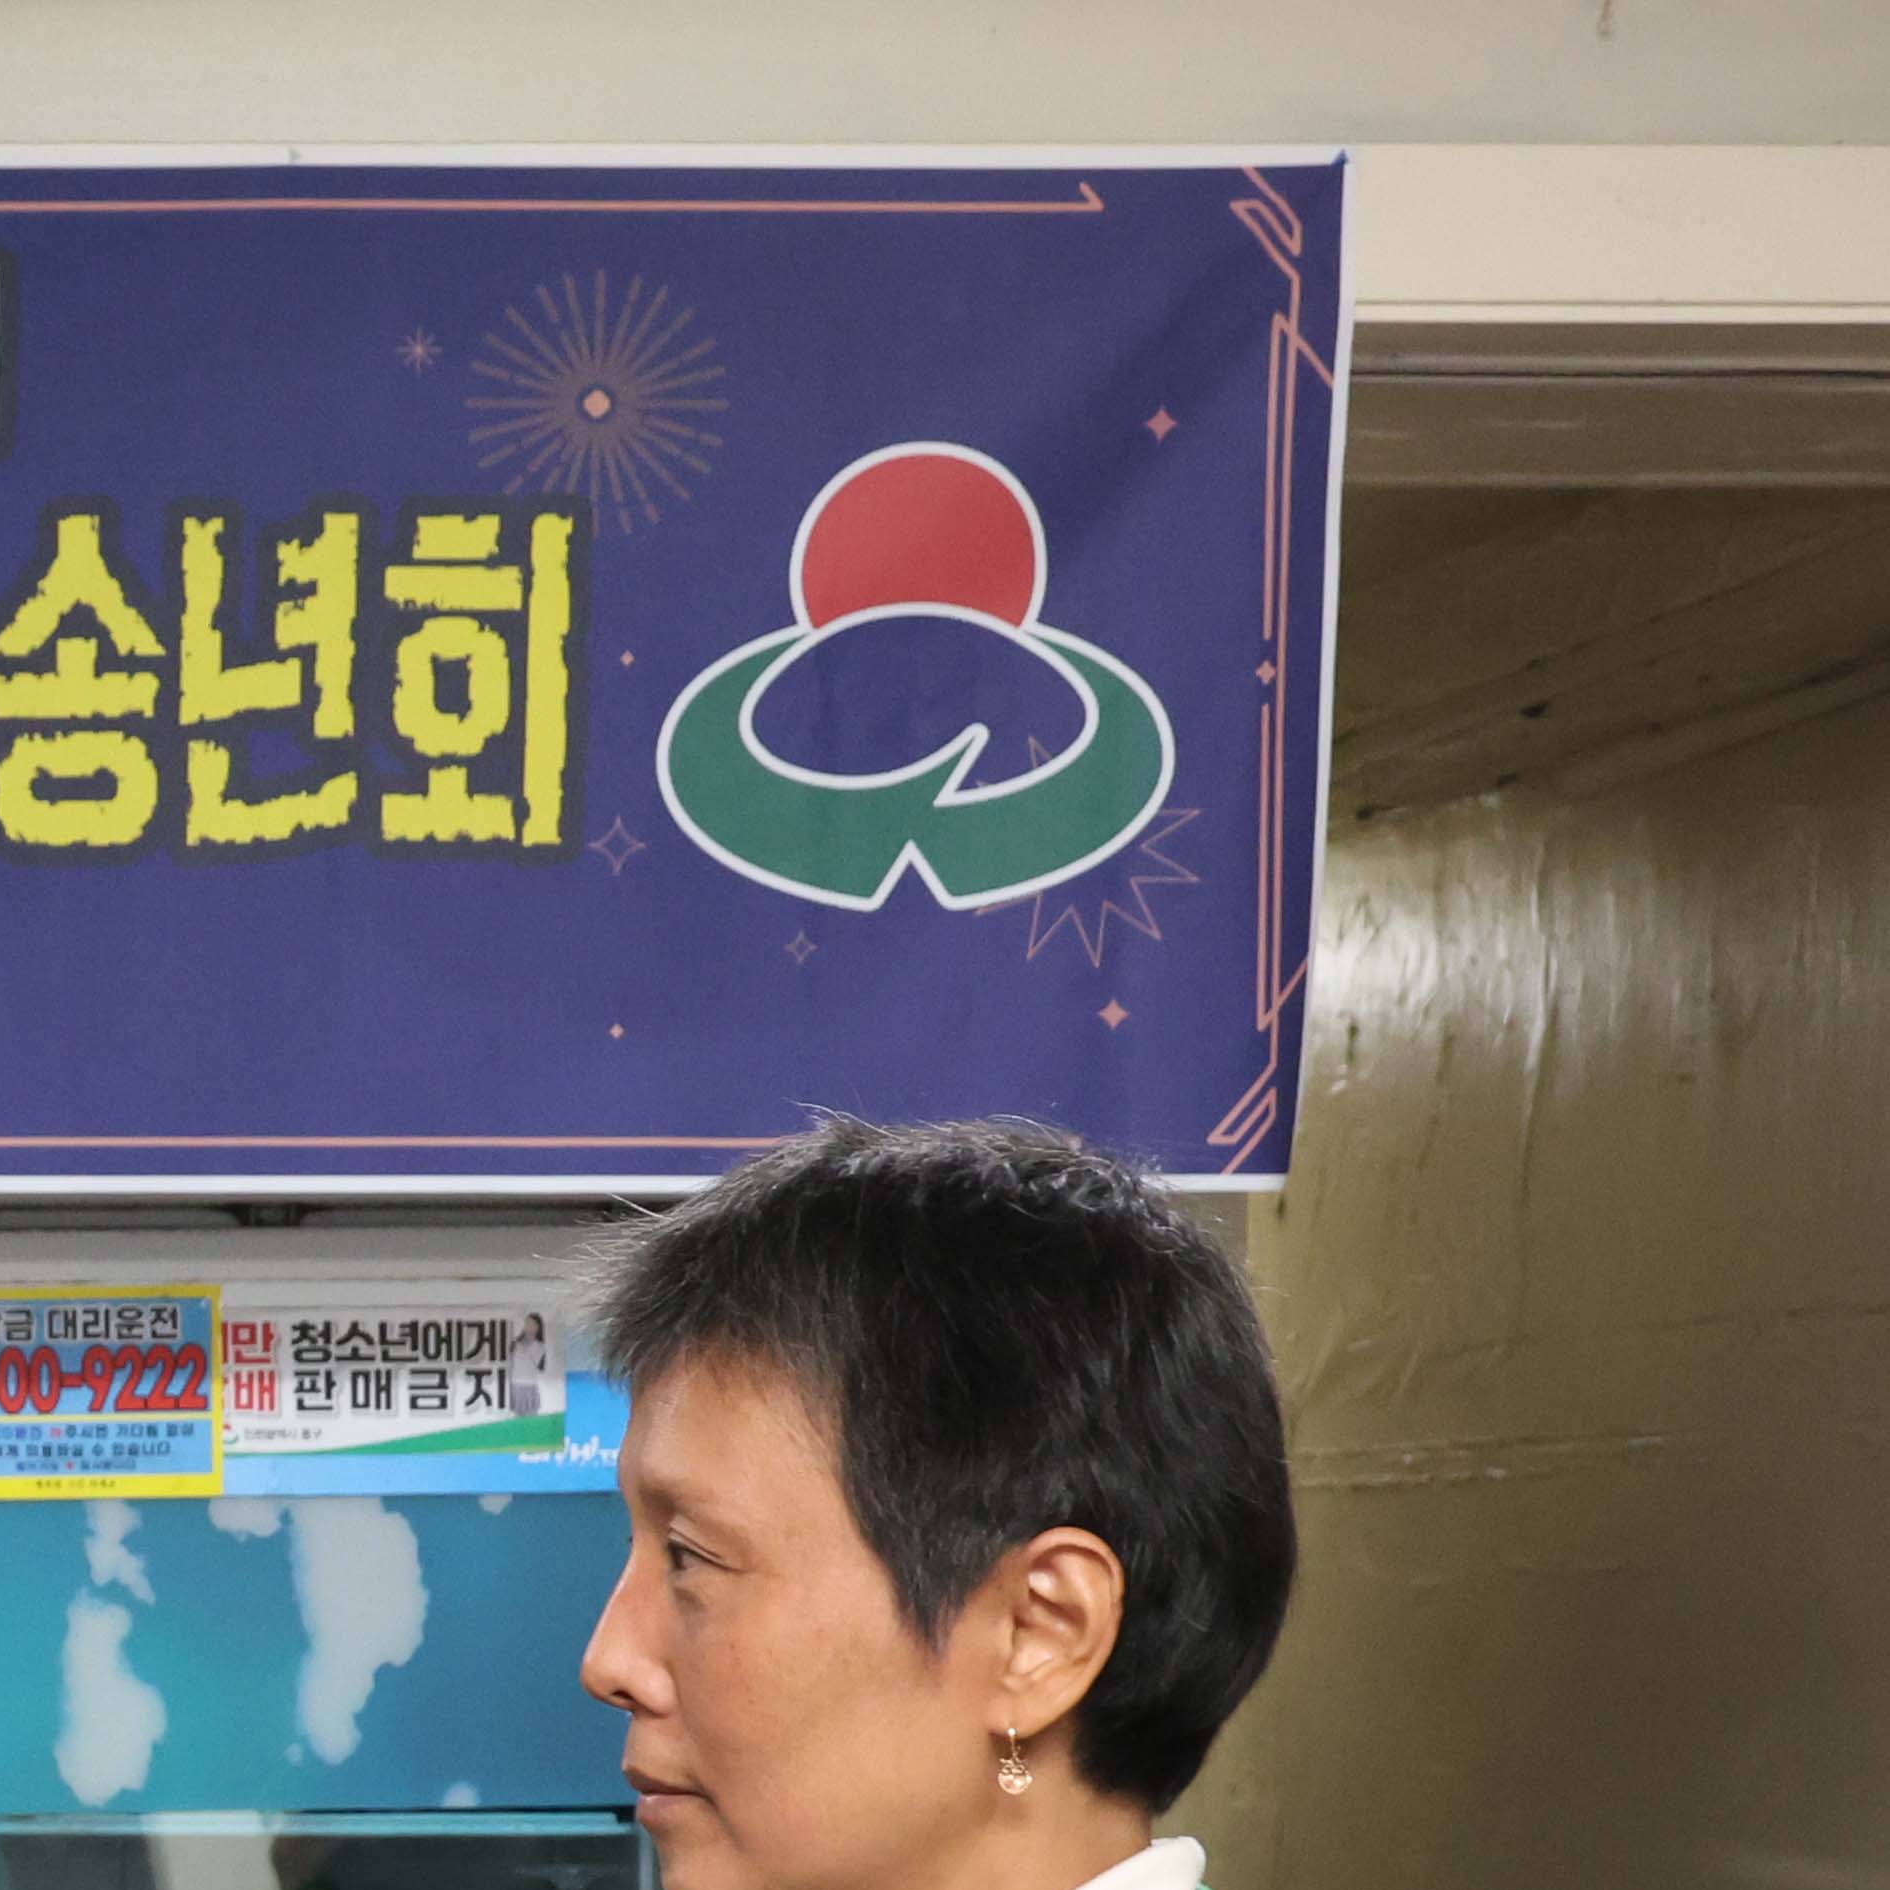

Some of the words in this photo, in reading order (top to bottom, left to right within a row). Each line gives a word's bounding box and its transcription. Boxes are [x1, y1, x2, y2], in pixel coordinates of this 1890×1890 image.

[46, 1305, 180, 1341] 대리운전
[221, 1320, 275, 1365] 만
[290, 1318, 508, 1364] 청소년에게
[221, 1368, 276, 1413] 배
